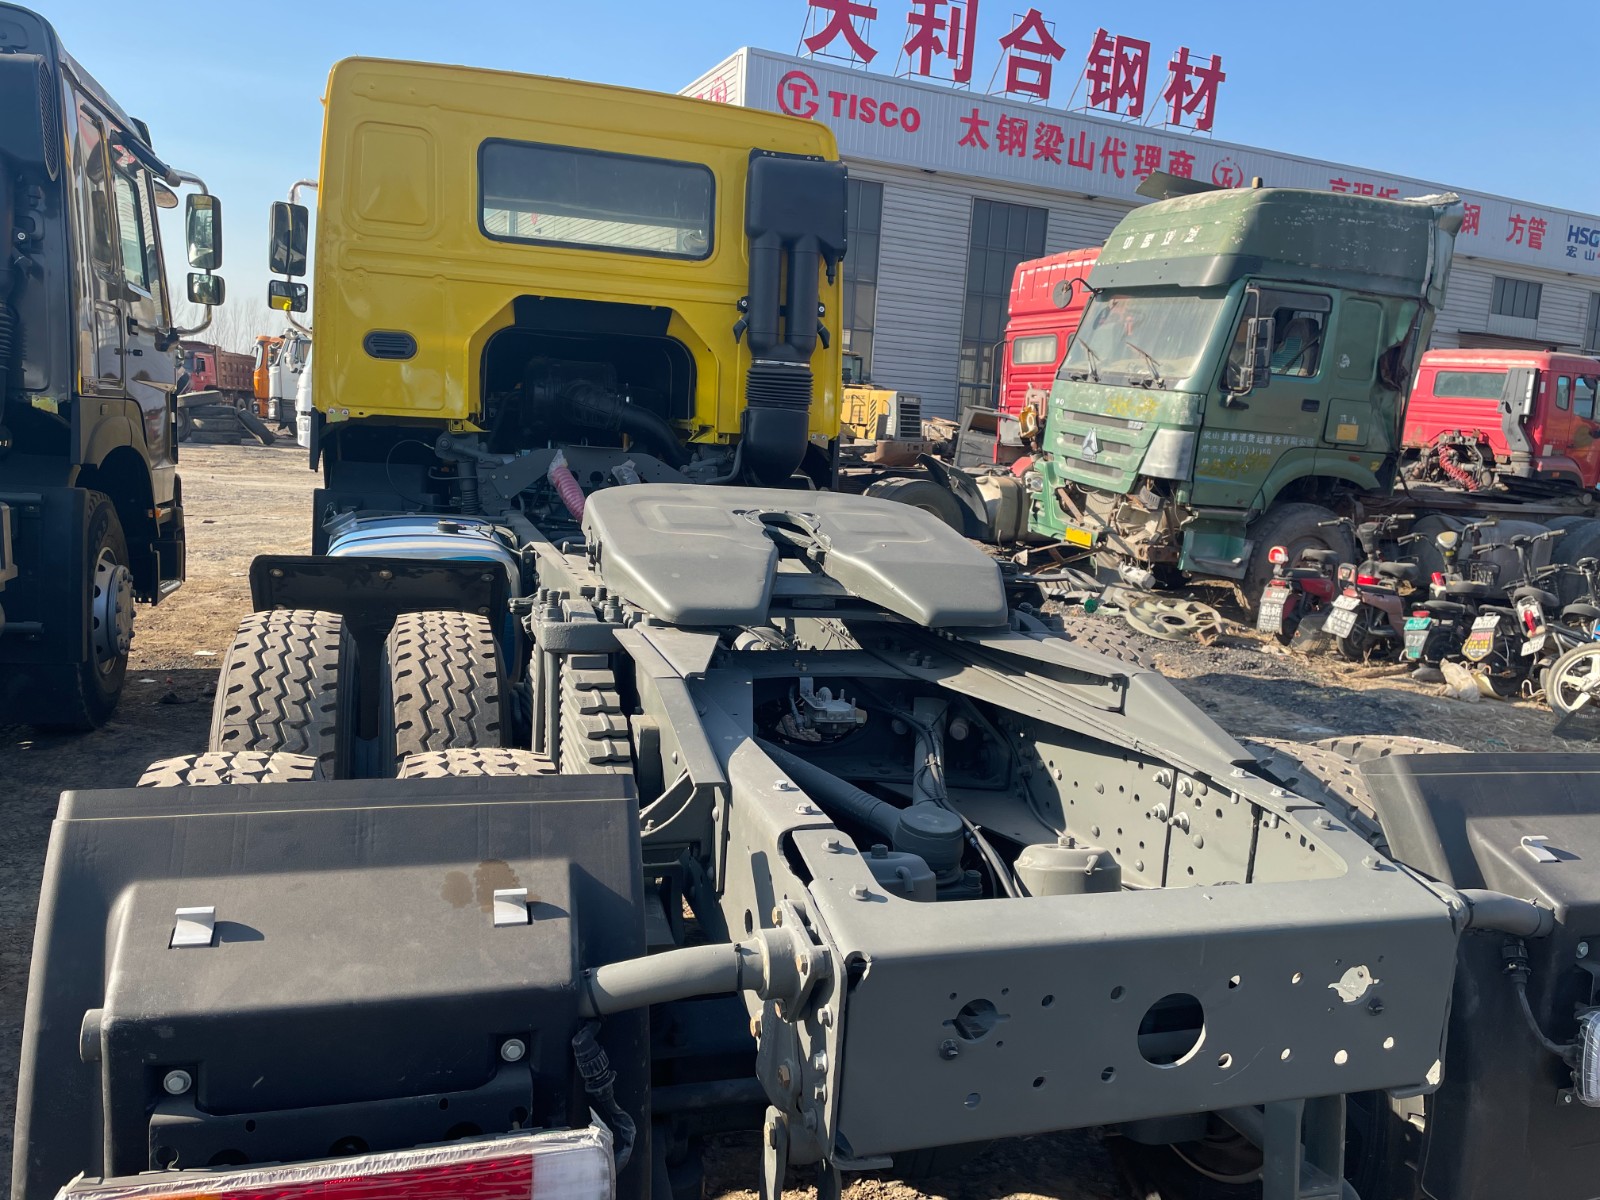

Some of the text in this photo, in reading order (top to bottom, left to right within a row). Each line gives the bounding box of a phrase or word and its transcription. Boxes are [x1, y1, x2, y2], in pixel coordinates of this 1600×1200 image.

[828, 90, 921, 133] TISCO
[957, 108, 1196, 182] 太钢梁山代理商
[1506, 213, 1548, 250] 方管
[1567, 225, 1600, 248] HSG
